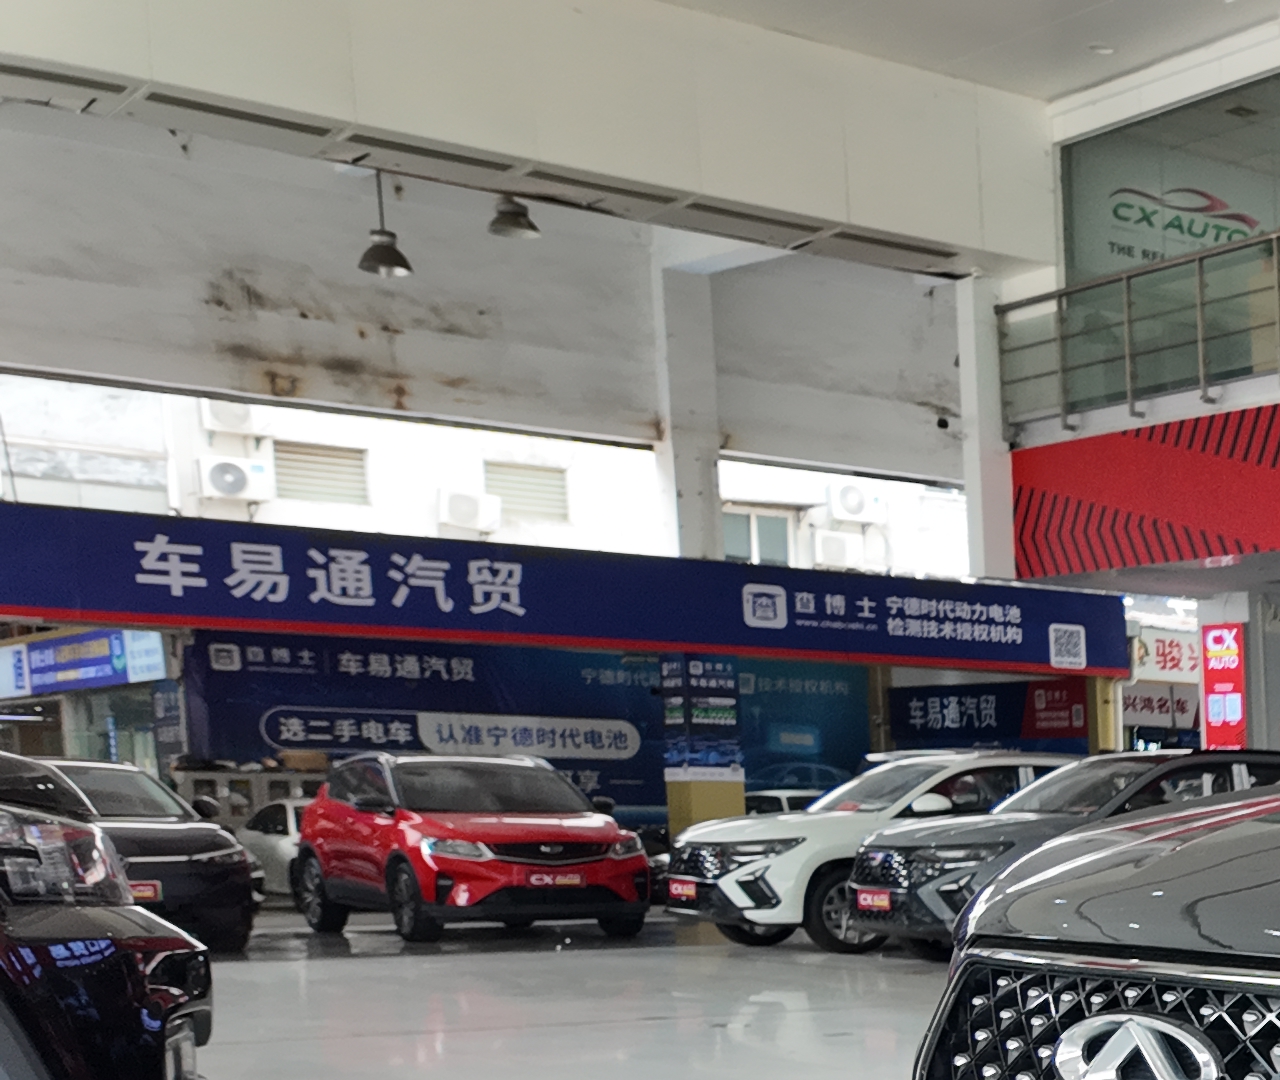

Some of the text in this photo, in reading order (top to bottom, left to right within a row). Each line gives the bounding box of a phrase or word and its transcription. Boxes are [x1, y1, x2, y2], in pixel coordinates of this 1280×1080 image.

[1112, 202, 1158, 228] CX
[134, 535, 527, 617] 车易通汽贸
[885, 595, 1022, 624] 宁德时代动力电池
[886, 617, 1023, 645] 检测技术授权机构
[1206, 628, 1239, 651] CX
[338, 652, 475, 681] 车易通汽贸
[1208, 656, 1239, 670] AUTO
[908, 695, 998, 730] 车易通汽贸
[279, 716, 629, 750] 选二手电车 认准宁德时代电池
